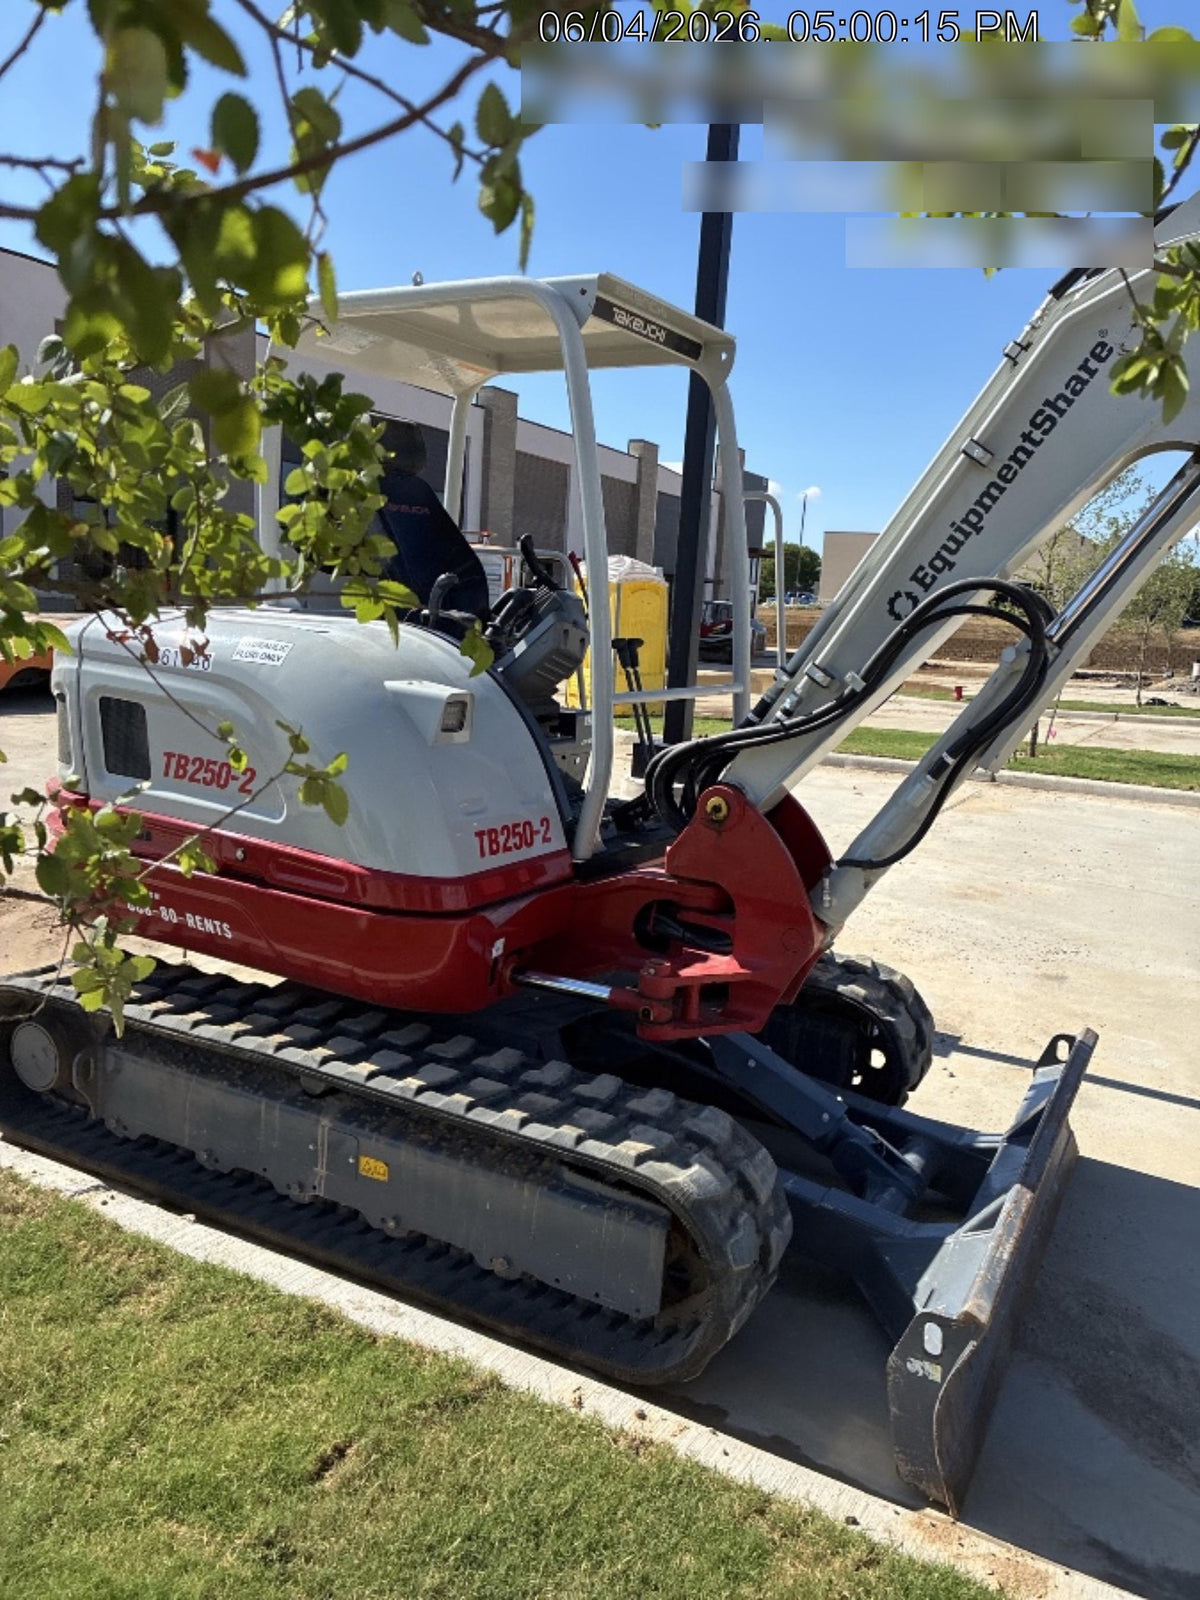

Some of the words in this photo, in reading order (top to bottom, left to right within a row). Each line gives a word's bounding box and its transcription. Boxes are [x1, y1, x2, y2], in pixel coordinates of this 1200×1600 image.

[612, 306, 667, 343] TAKEUCHI
[163, 751, 256, 795] TB250-2
[474, 816, 552, 858] TB250-2
